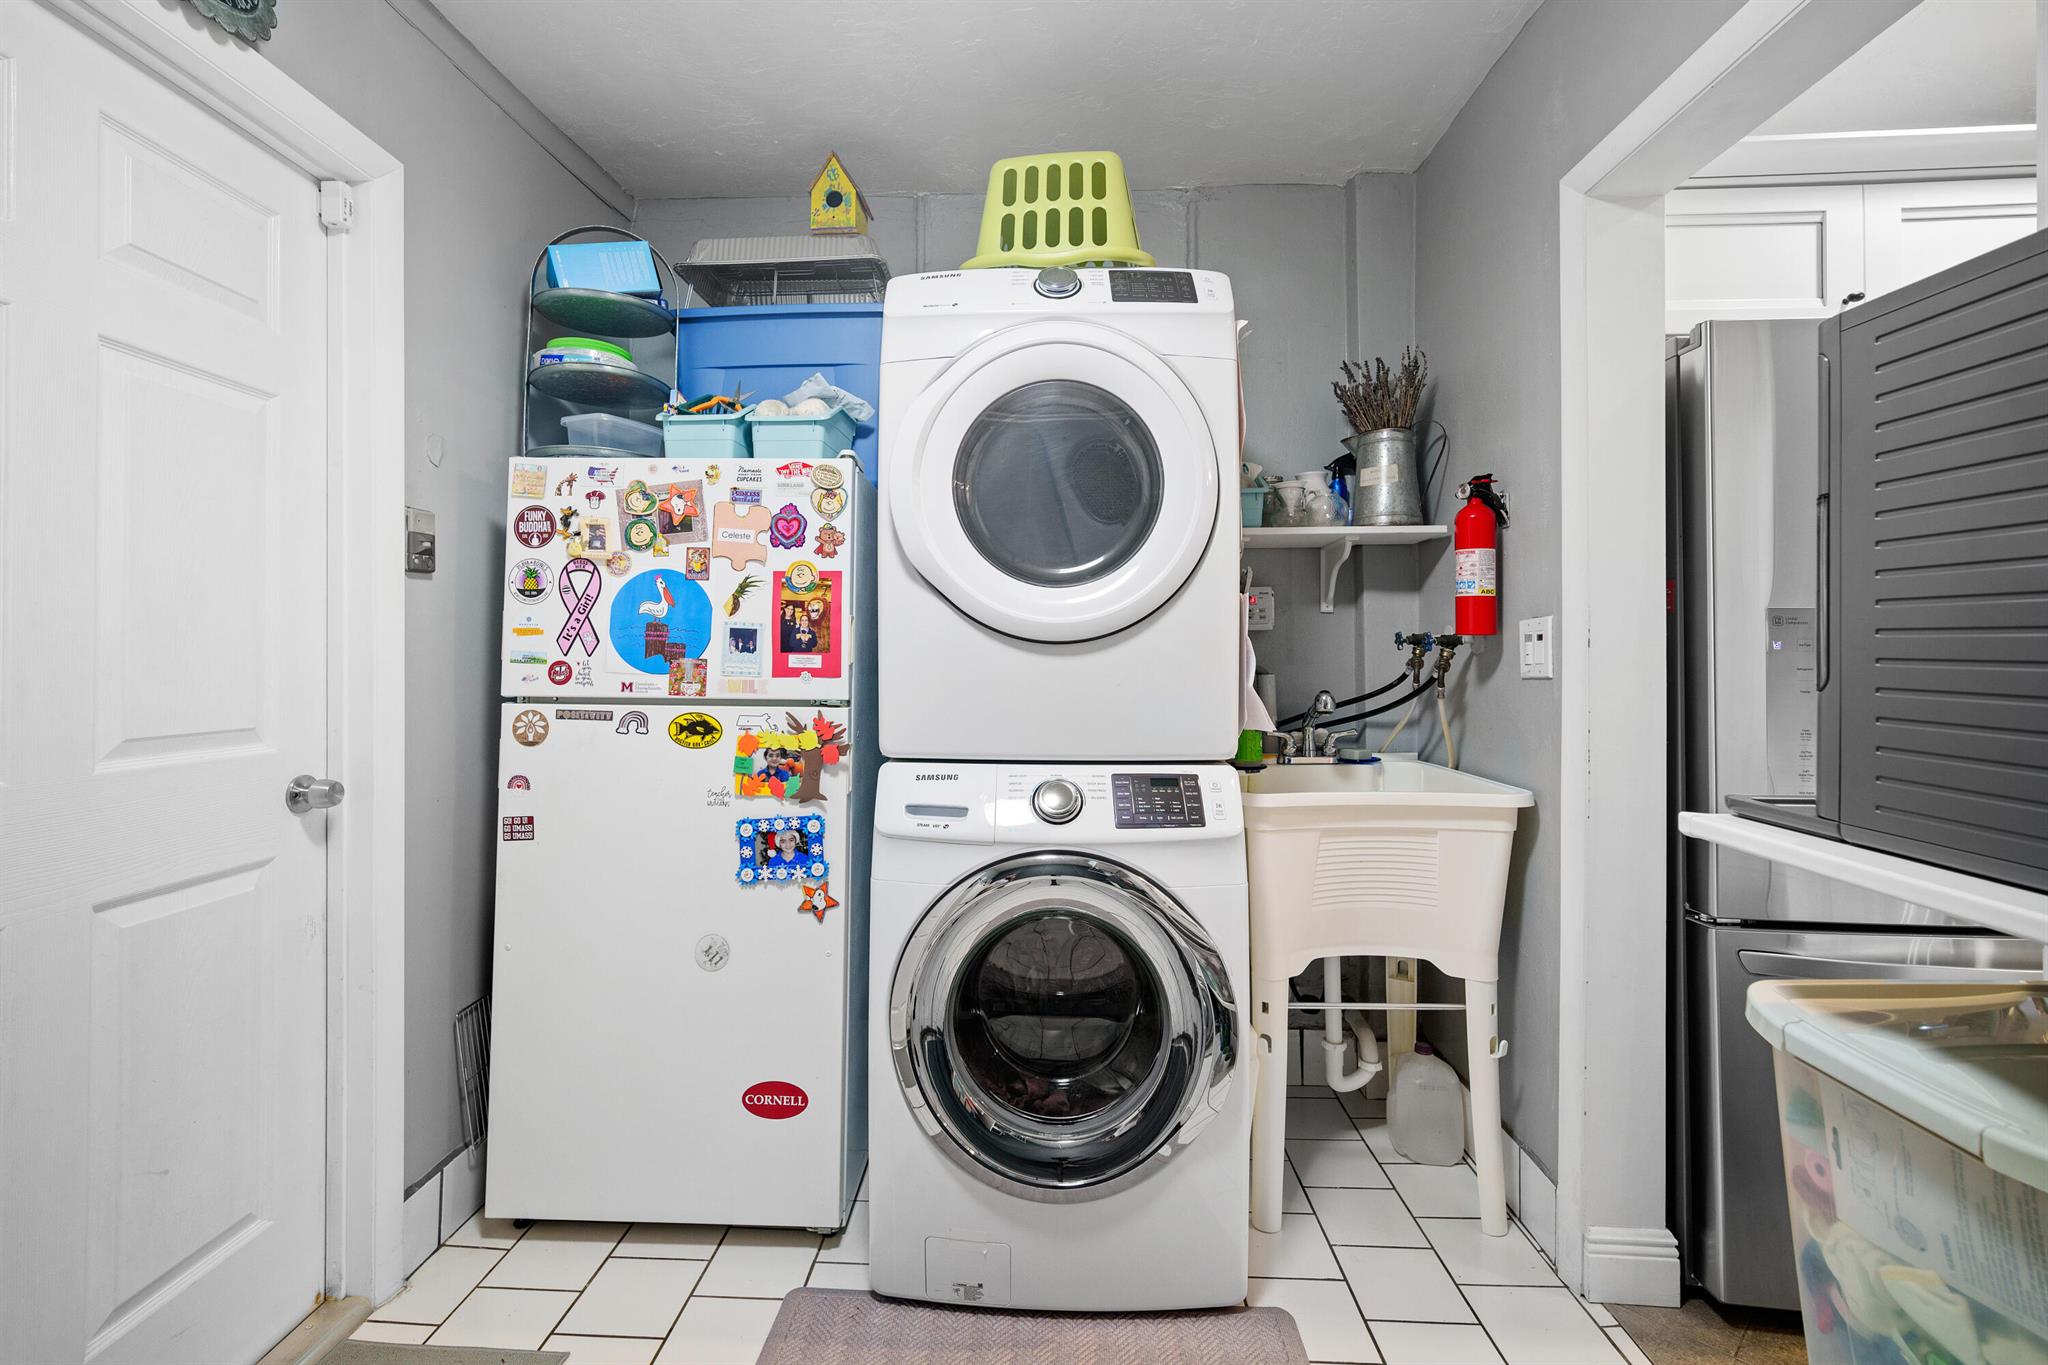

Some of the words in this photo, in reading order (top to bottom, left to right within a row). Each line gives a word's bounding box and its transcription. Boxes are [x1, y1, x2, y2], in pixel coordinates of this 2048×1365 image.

[524, 510, 547, 522] FUNKY
[721, 530, 751, 540] Celeste
[562, 625, 577, 641] It's
[577, 593, 594, 615] Girl!
[557, 710, 613, 720] POSITIVITY
[745, 1094, 806, 1106] CORNELL
